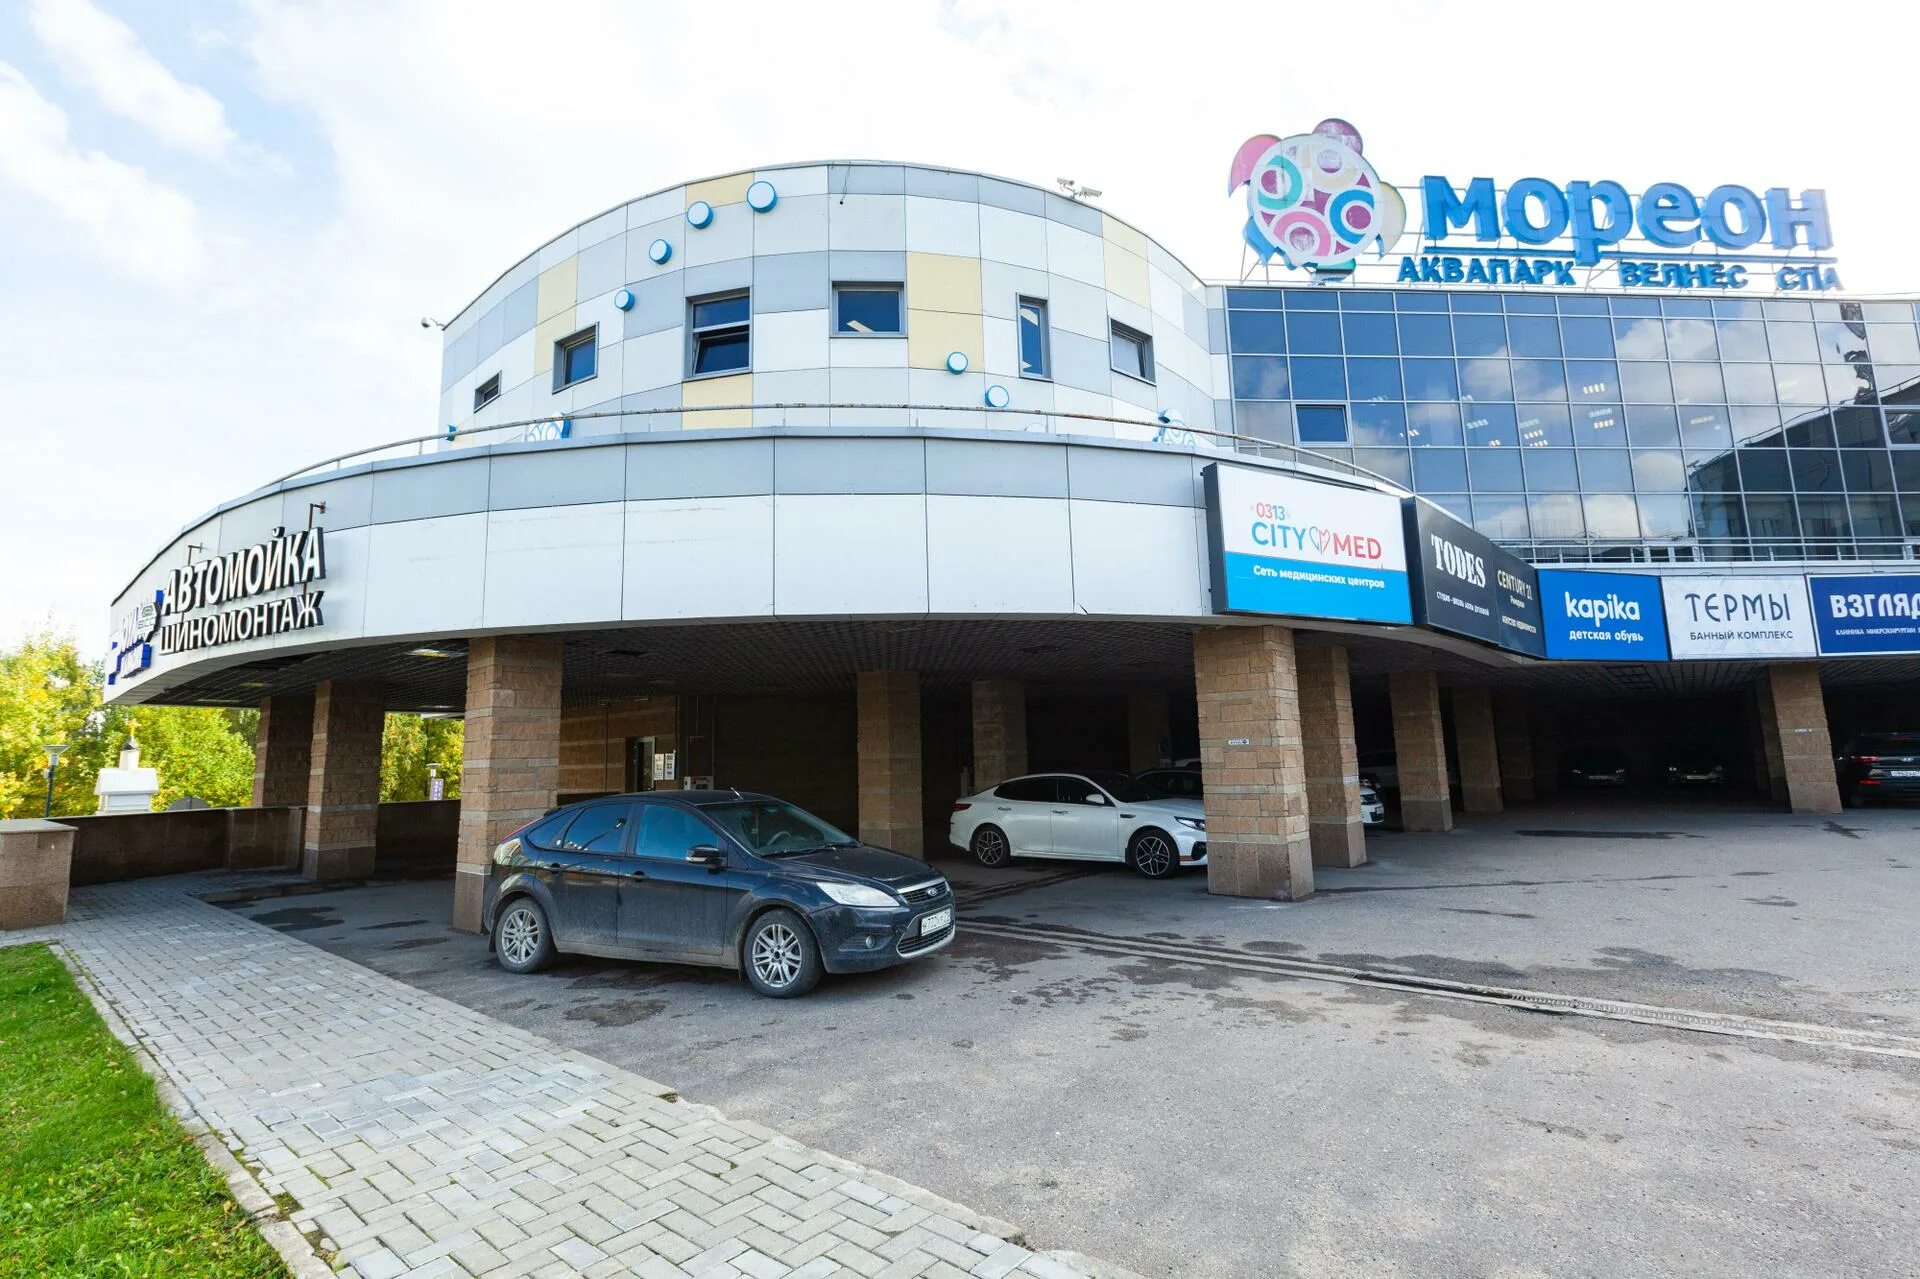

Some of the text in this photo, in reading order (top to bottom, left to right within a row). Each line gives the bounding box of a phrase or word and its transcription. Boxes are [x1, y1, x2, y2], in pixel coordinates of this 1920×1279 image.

[1397, 256, 1845, 291] АКВАПАРК ВЕЛНЕС СПА
[1256, 502, 1286, 521] 0313
[1251, 521, 1382, 560] CITY MED
[161, 527, 326, 616] АВТОМОЙКА
[1253, 564, 1386, 589] Сеть медицинских центров
[1431, 533, 1486, 588] TODES
[1497, 569, 1526, 597] CENTURY
[159, 591, 324, 655] ШИНОМОНТАЖ
[1565, 591, 1640, 627] kapika
[1685, 593, 1791, 622] ТЕРМЫ
[1569, 629, 1644, 644] детская обувь
[1690, 629, 1794, 641] БАННЫЙ КОМПЛЕКС
